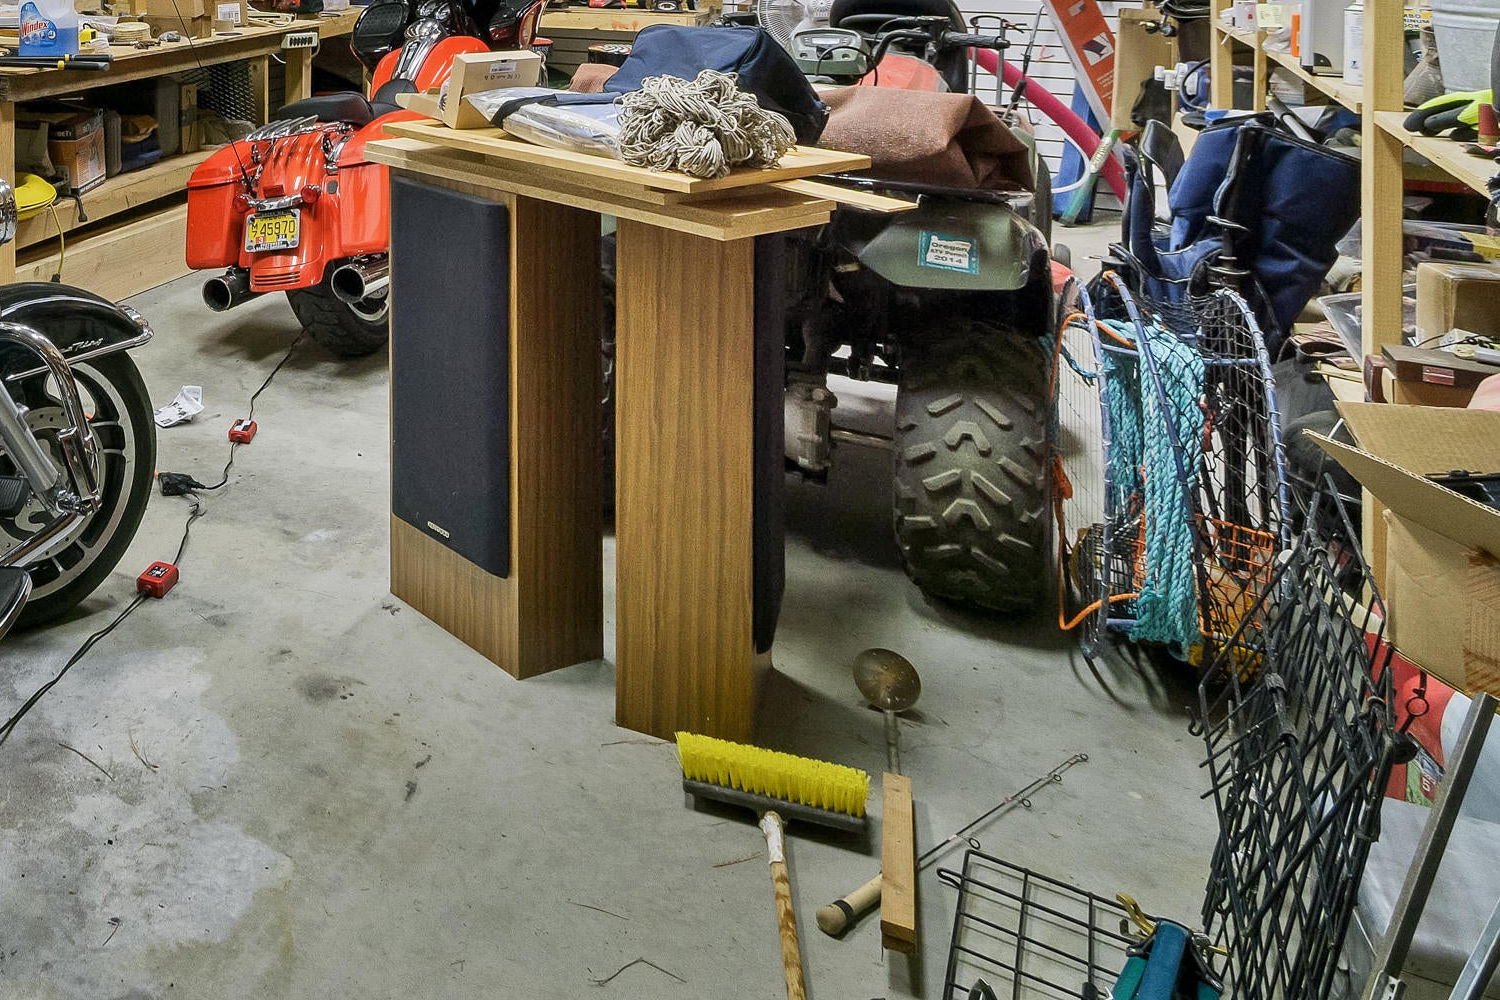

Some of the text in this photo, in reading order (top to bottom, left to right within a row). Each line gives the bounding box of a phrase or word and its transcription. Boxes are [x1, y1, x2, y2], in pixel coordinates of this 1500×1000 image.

[21, 20, 48, 38] Windex
[260, 219, 296, 238] 45970
[931, 241, 968, 252] Oregon
[933, 254, 963, 264] 2014
